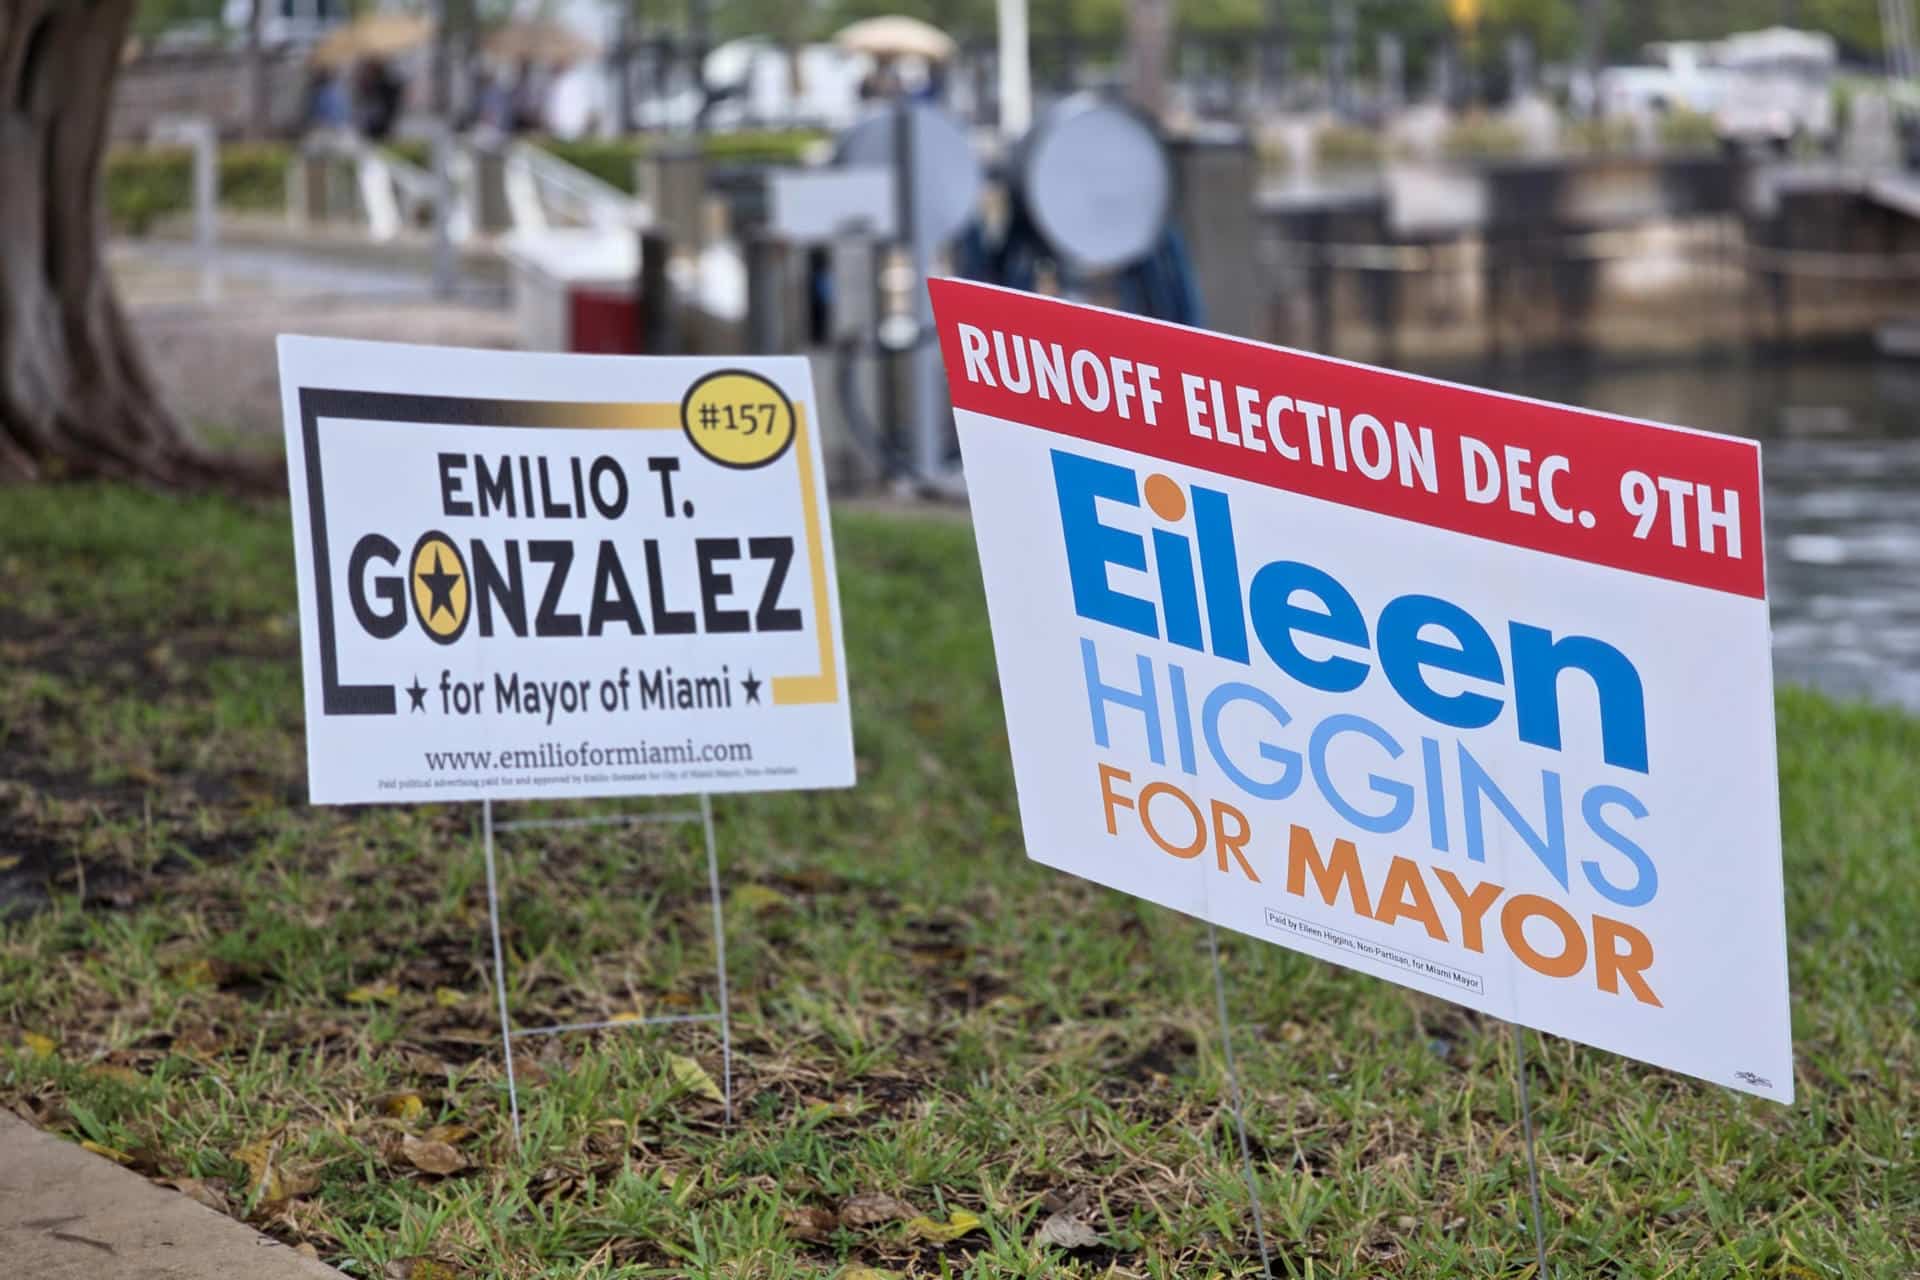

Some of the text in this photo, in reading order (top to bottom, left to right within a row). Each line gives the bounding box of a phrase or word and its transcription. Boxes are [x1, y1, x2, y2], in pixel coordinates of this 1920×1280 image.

[699, 403, 777, 435] #157
[958, 323, 1742, 559] RUNOFF ELECTION DEC. 9TH
[437, 452, 695, 520] EMILIO T.
[348, 530, 803, 645] GONZALEZ
[1049, 448, 1649, 775] Eileen
[439, 664, 732, 726] for Mayor of Miami
[424, 739, 754, 771] www.emilioformiami.com
[1080, 636, 1659, 908] HIGGINS
[1098, 762, 1664, 1008] FOR MAYOR
[1269, 912, 1287, 925] Paid
[1288, 919, 1298, 931] by
[1299, 922, 1322, 938] Eileen
[1323, 930, 1356, 949] Higgins,
[1412, 959, 1425, 970] for
[1426, 962, 1452, 979] Miami
[1452, 971, 1479, 988] Mayor
